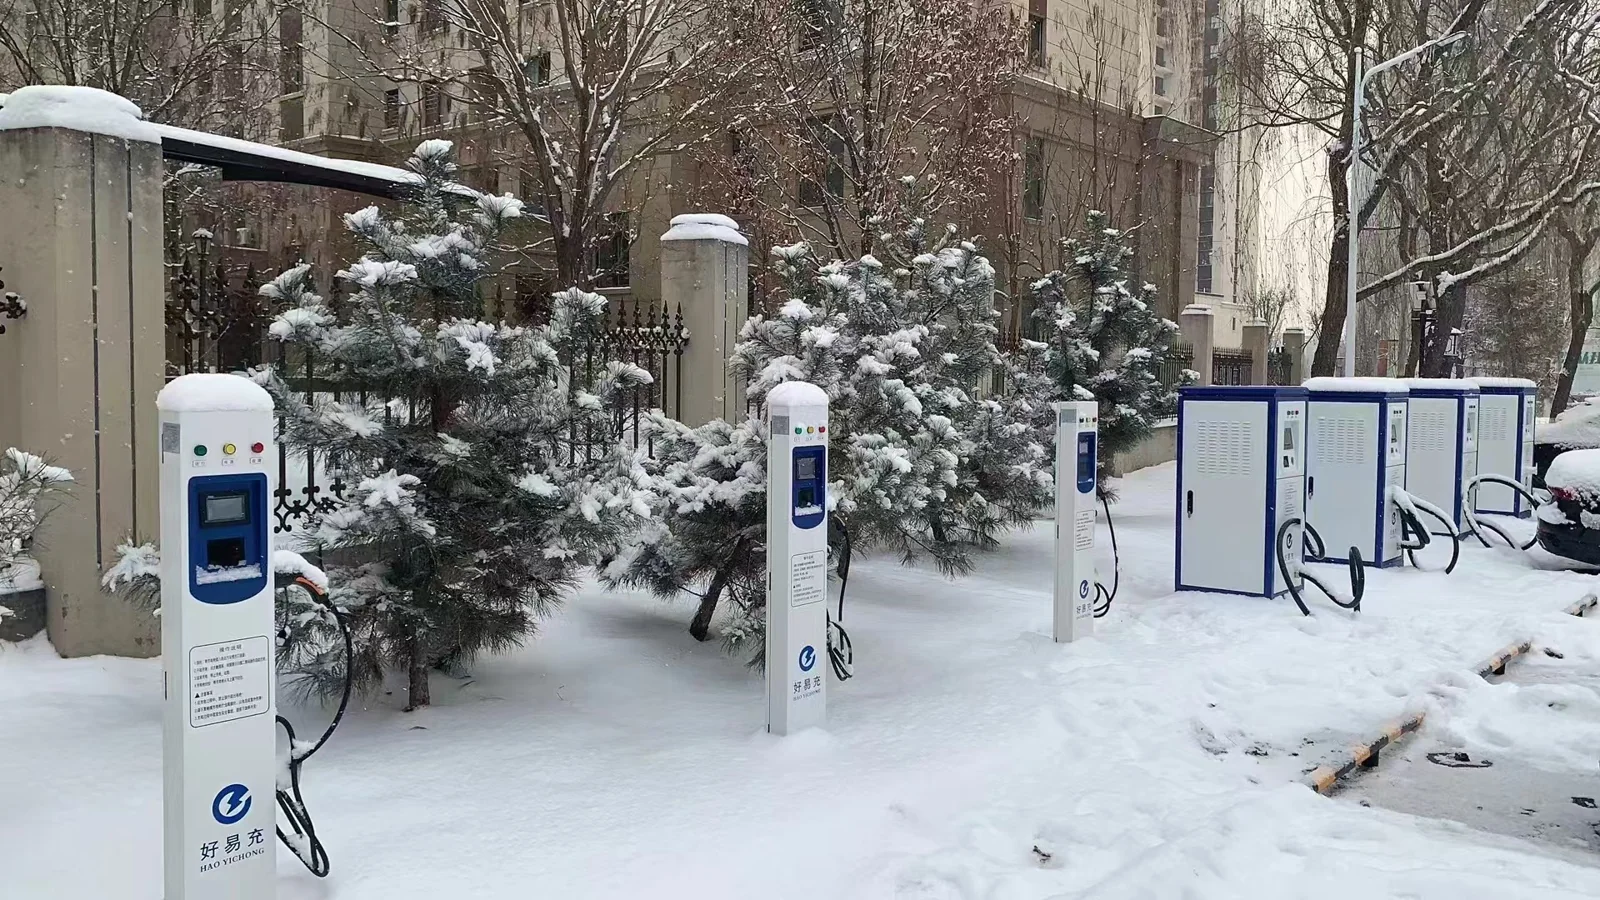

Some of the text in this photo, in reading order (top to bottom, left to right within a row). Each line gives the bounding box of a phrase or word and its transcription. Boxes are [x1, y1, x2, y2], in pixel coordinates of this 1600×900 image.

[793, 675, 821, 694] 好易充
[200, 828, 264, 861] 好易充
[200, 848, 265, 873] HAO YICHONG
